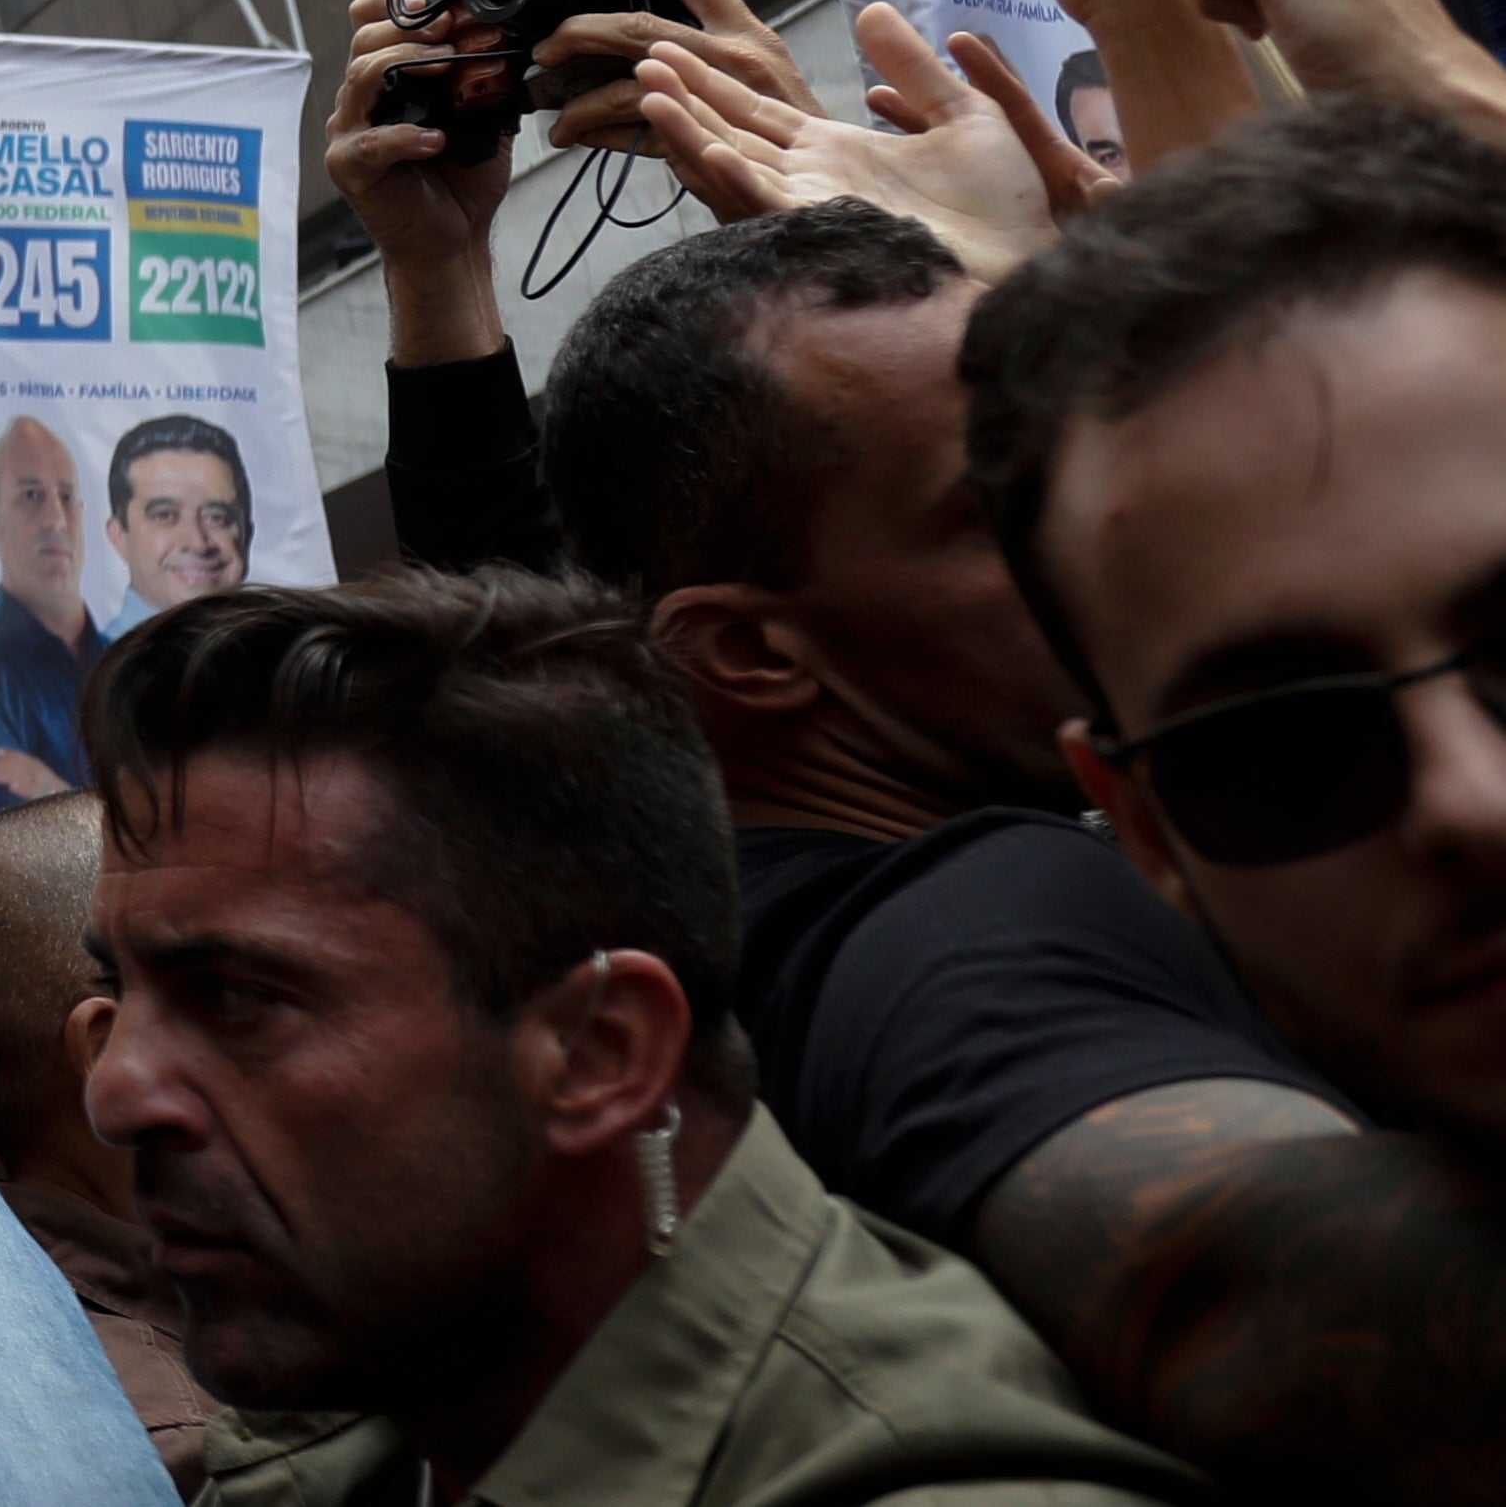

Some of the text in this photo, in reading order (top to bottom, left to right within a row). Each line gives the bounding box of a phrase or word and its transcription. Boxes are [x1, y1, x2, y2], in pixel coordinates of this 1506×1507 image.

[145, 130, 239, 164] SARGENTO
[142, 162, 241, 196] RODRIGUES
[24, 205, 111, 221] FEDERAL
[139, 255, 259, 321] 22122
